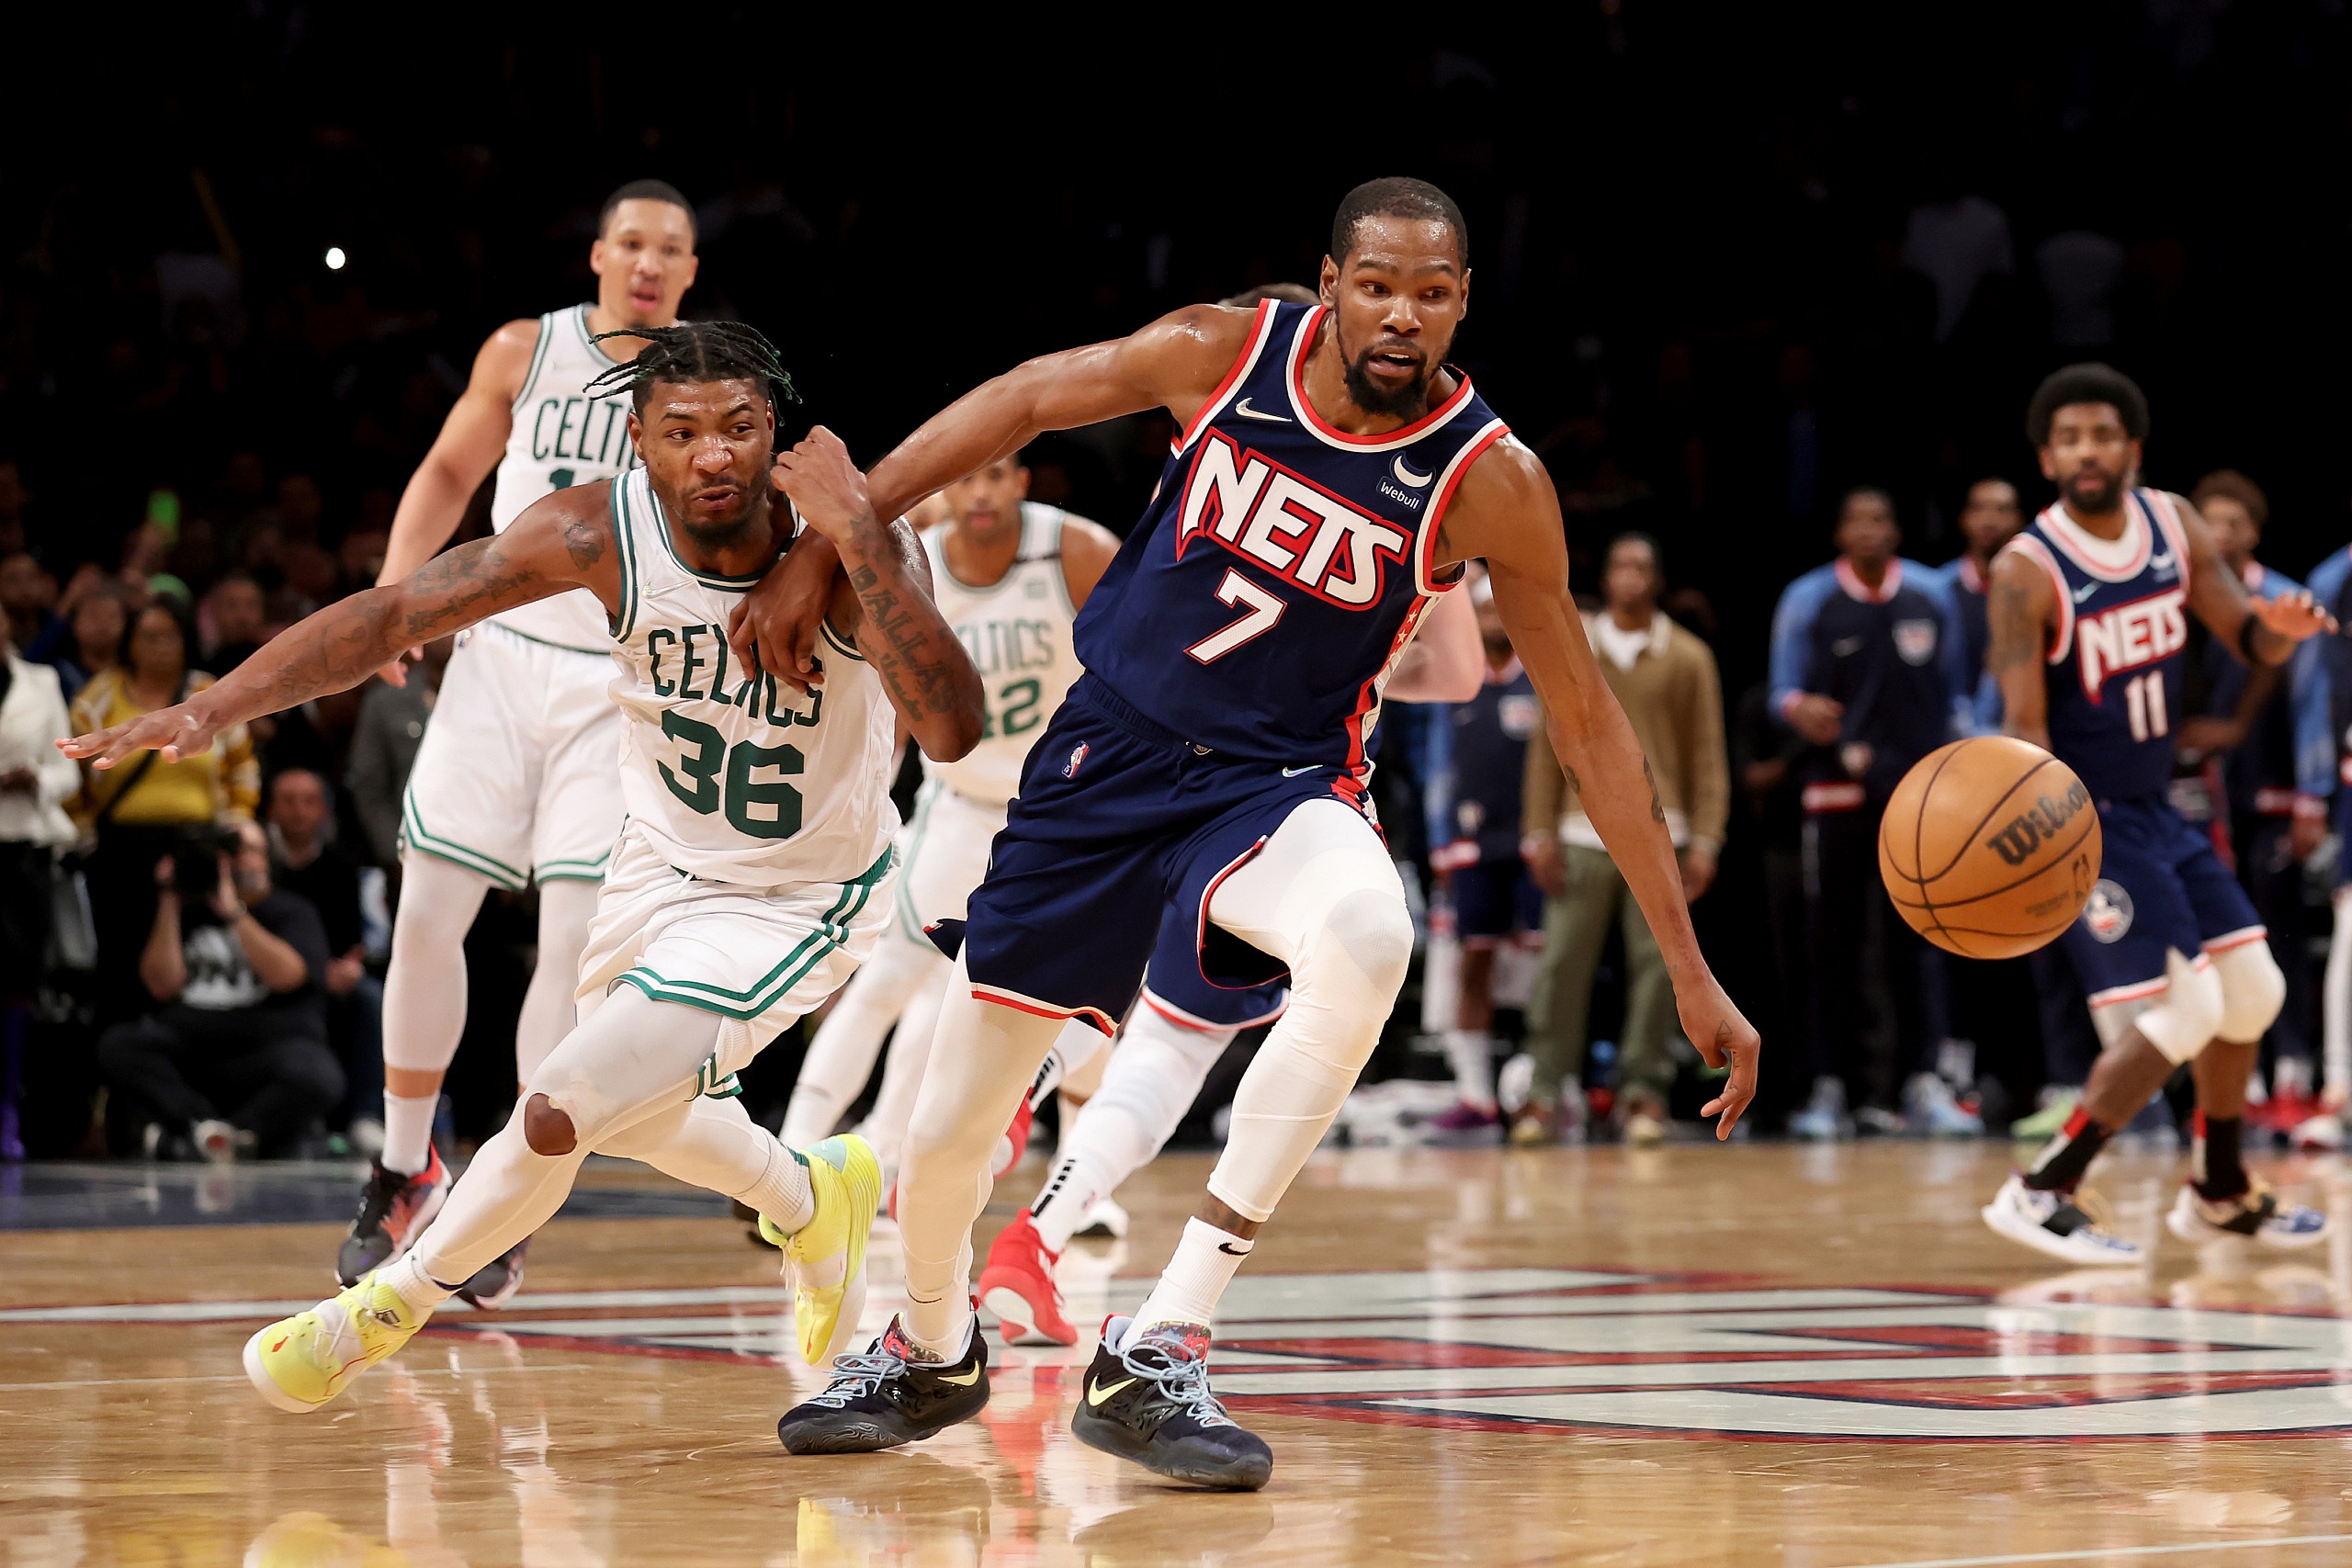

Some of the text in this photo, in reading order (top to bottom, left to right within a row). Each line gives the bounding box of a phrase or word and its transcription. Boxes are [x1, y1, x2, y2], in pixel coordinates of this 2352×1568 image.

[533, 398, 638, 469] CELTI
[1177, 428, 1412, 610] NETS
[1380, 481, 1419, 510] Webull
[1183, 566, 1287, 665] 7
[2076, 584, 2188, 705] NETS
[981, 679, 1042, 739] 2
[2124, 669, 2168, 742] 11
[656, 709, 805, 839] 36
